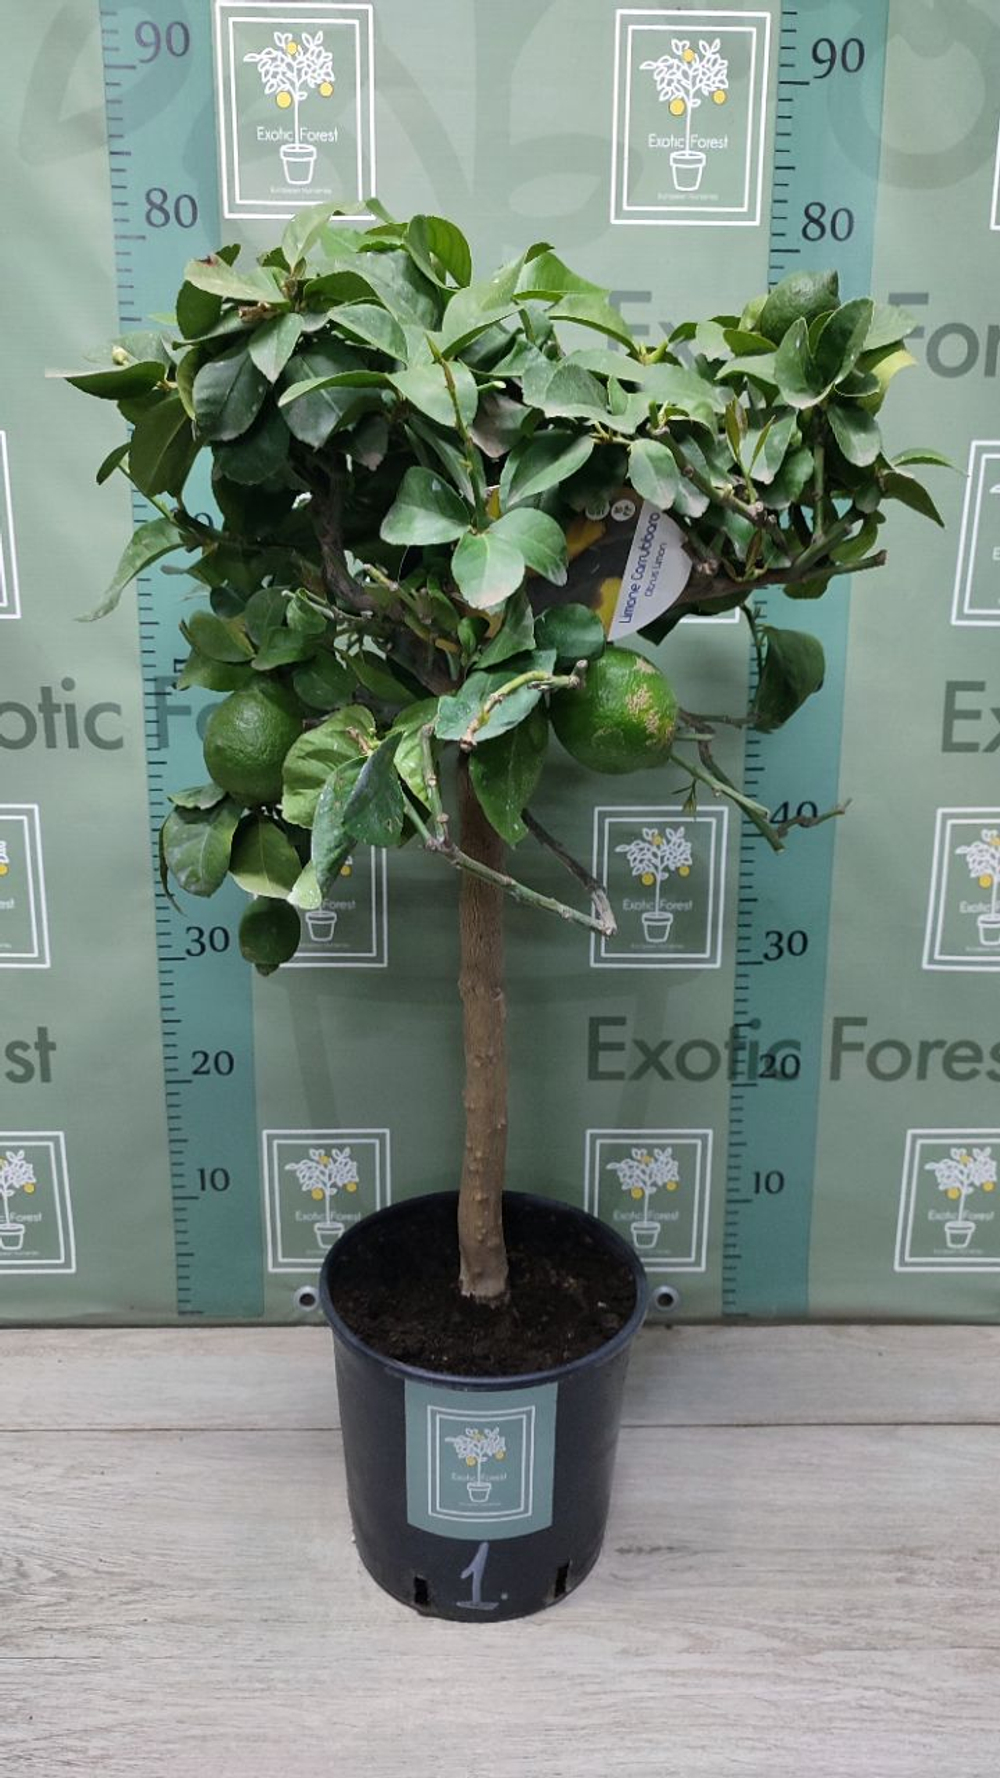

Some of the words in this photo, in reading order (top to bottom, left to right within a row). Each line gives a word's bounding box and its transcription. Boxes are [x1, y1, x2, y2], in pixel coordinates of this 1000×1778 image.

[134, 21, 191, 63] 90
[811, 38, 866, 79] 90
[256, 126, 294, 141] Exotic
[300, 127, 338, 142] Forest
[648, 133, 684, 148] Exotic
[690, 134, 728, 149] Forest
[144, 187, 199, 228] 80
[801, 202, 855, 242] 80
[618, 583, 641, 624] Limone
[185, 926, 230, 957] 30
[763, 930, 808, 961] 30
[191, 1051, 235, 1077] 20
[587, 1016, 802, 1082] Exotic
[759, 1053, 801, 1079] 20
[198, 1168, 230, 1192] 10
[753, 1170, 785, 1194] 10
